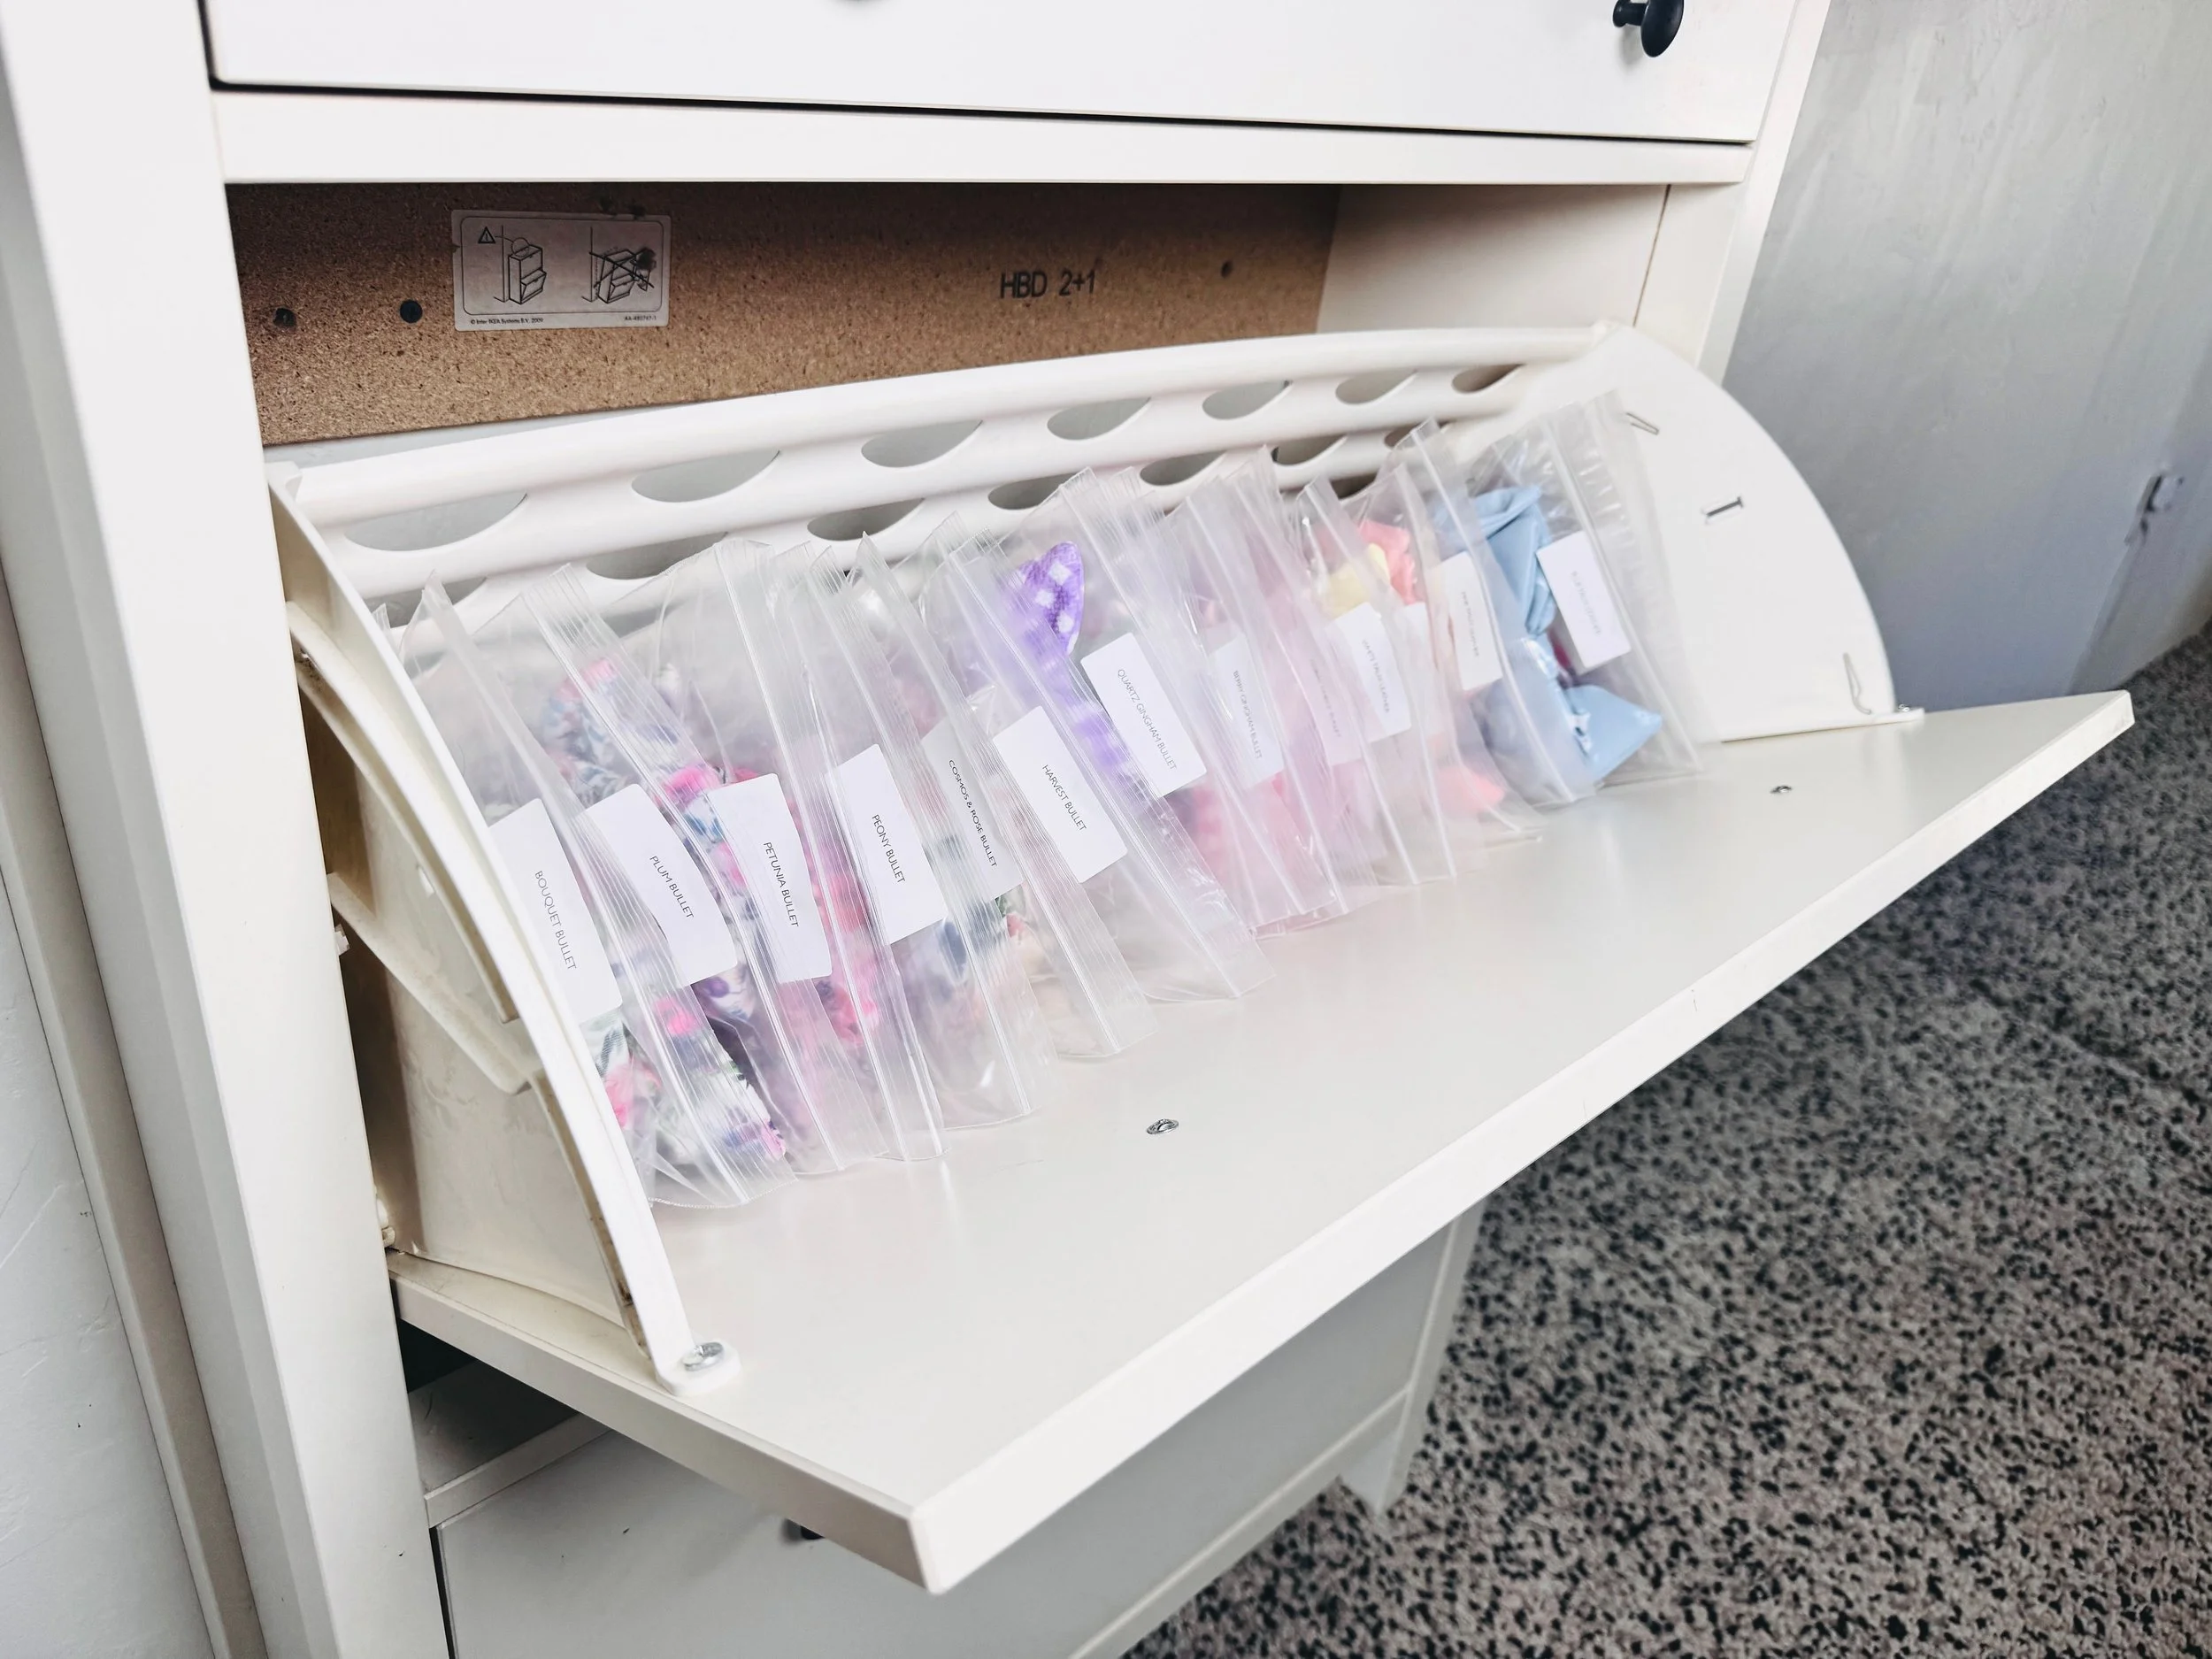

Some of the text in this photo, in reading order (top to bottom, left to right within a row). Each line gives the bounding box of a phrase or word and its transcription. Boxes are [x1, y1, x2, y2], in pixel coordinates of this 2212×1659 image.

[1000, 269, 1095, 298] HBD 2+1
[1118, 669, 1178, 771] QUARTZ GINGHAM BULLET
[949, 759, 997, 868] COSMOS & ROSE BULLET
[1041, 764, 1087, 832] HARVEST BULLET
[649, 856, 695, 918] PLUM BULLET
[763, 841, 799, 927] PETUNIA BULLET
[872, 814, 906, 884] PEONY BULLET
[534, 870, 577, 971] BOUQUET BULLET
